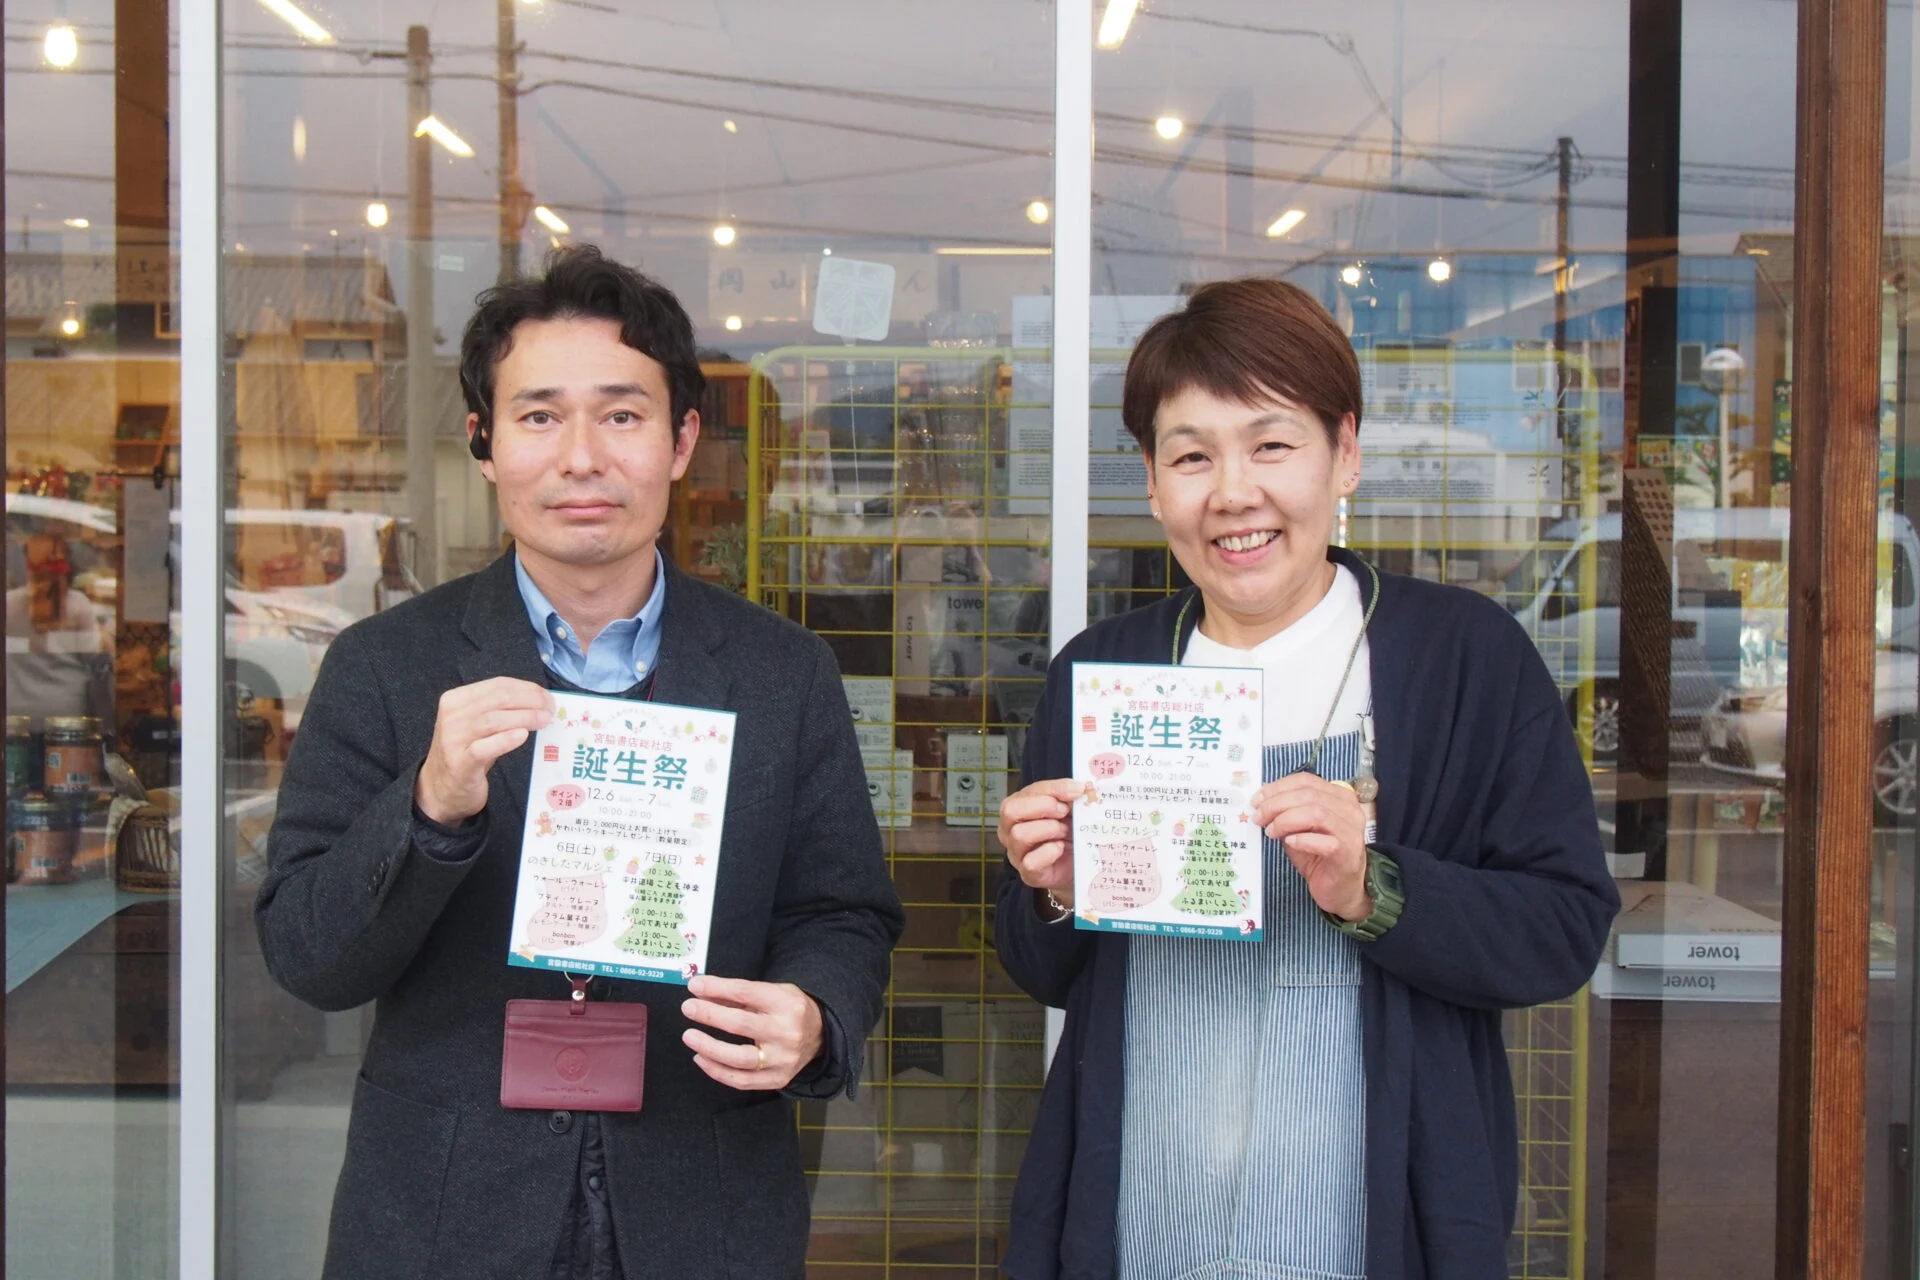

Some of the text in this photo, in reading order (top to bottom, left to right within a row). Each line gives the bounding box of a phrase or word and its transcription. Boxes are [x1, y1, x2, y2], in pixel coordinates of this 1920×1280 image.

[947, 597, 985, 610] towe
[1110, 712, 1223, 751] 誕生祭
[593, 733, 674, 752] 宮脇書店総社店
[571, 743, 688, 791] 誕生祭
[1092, 758, 1121, 768] ポイント
[1127, 753, 1154, 767] 12.6
[550, 789, 581, 800] ポイント
[587, 786, 615, 802] 12.6
[1104, 808, 1143, 822] 6日(土)
[1189, 813, 1226, 825] 7日(日)
[1079, 823, 1161, 838] のきしたマルシェ
[556, 841, 597, 857] 6日(土)
[527, 855, 614, 875] のきしたマルシェ
[643, 851, 683, 866] 7日(日)
[552, 931, 576, 939] bonbon
[1688, 946, 1740, 961] tower
[1663, 976, 1715, 990] tower
